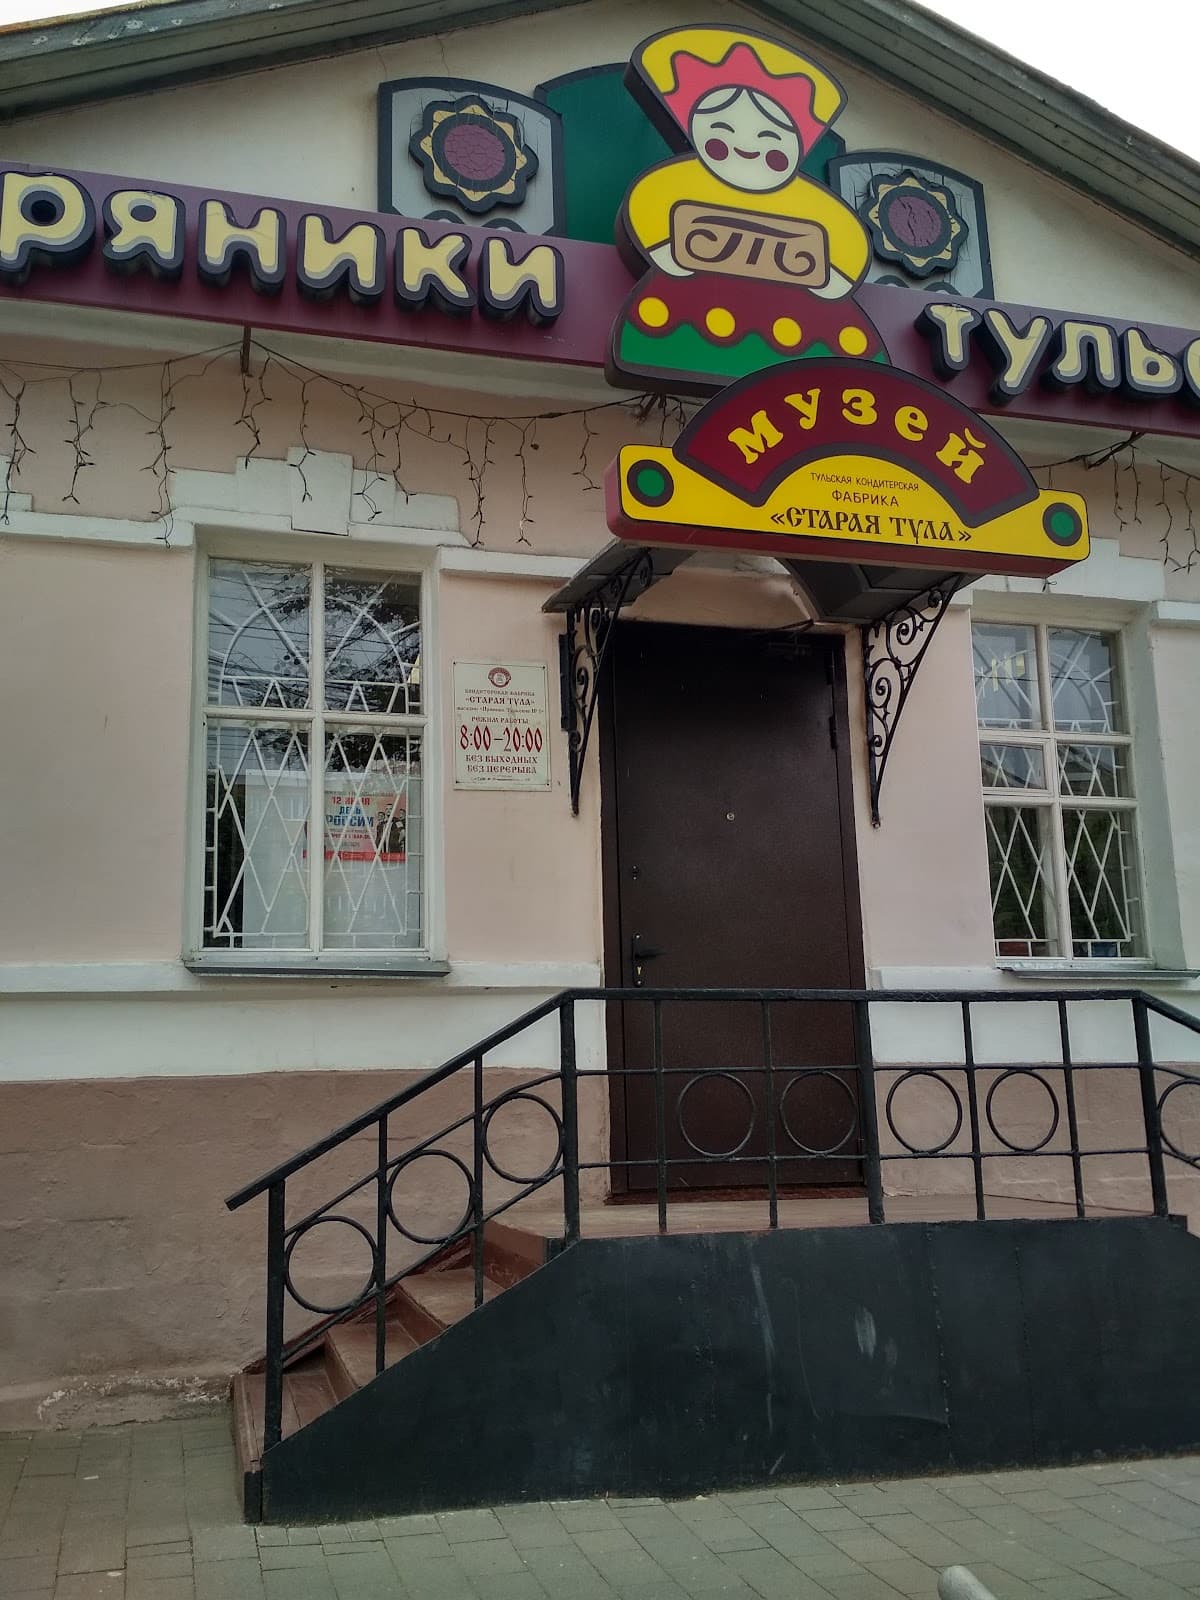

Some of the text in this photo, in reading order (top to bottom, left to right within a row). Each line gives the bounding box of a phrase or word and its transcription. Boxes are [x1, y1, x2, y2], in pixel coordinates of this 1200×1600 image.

[810, 472, 919, 491] ТУЛЬСКАЯ КОНДИТЕРСКАЯ
[831, 489, 899, 507] ФАБРИКА
[770, 506, 972, 544] «СТАРАЯ ТУЛА»
[465, 754, 538, 764] БЕЗ ВЫХОДНЫХ
[467, 764, 537, 774] БЕЗ ПЕРЕРЫВА
